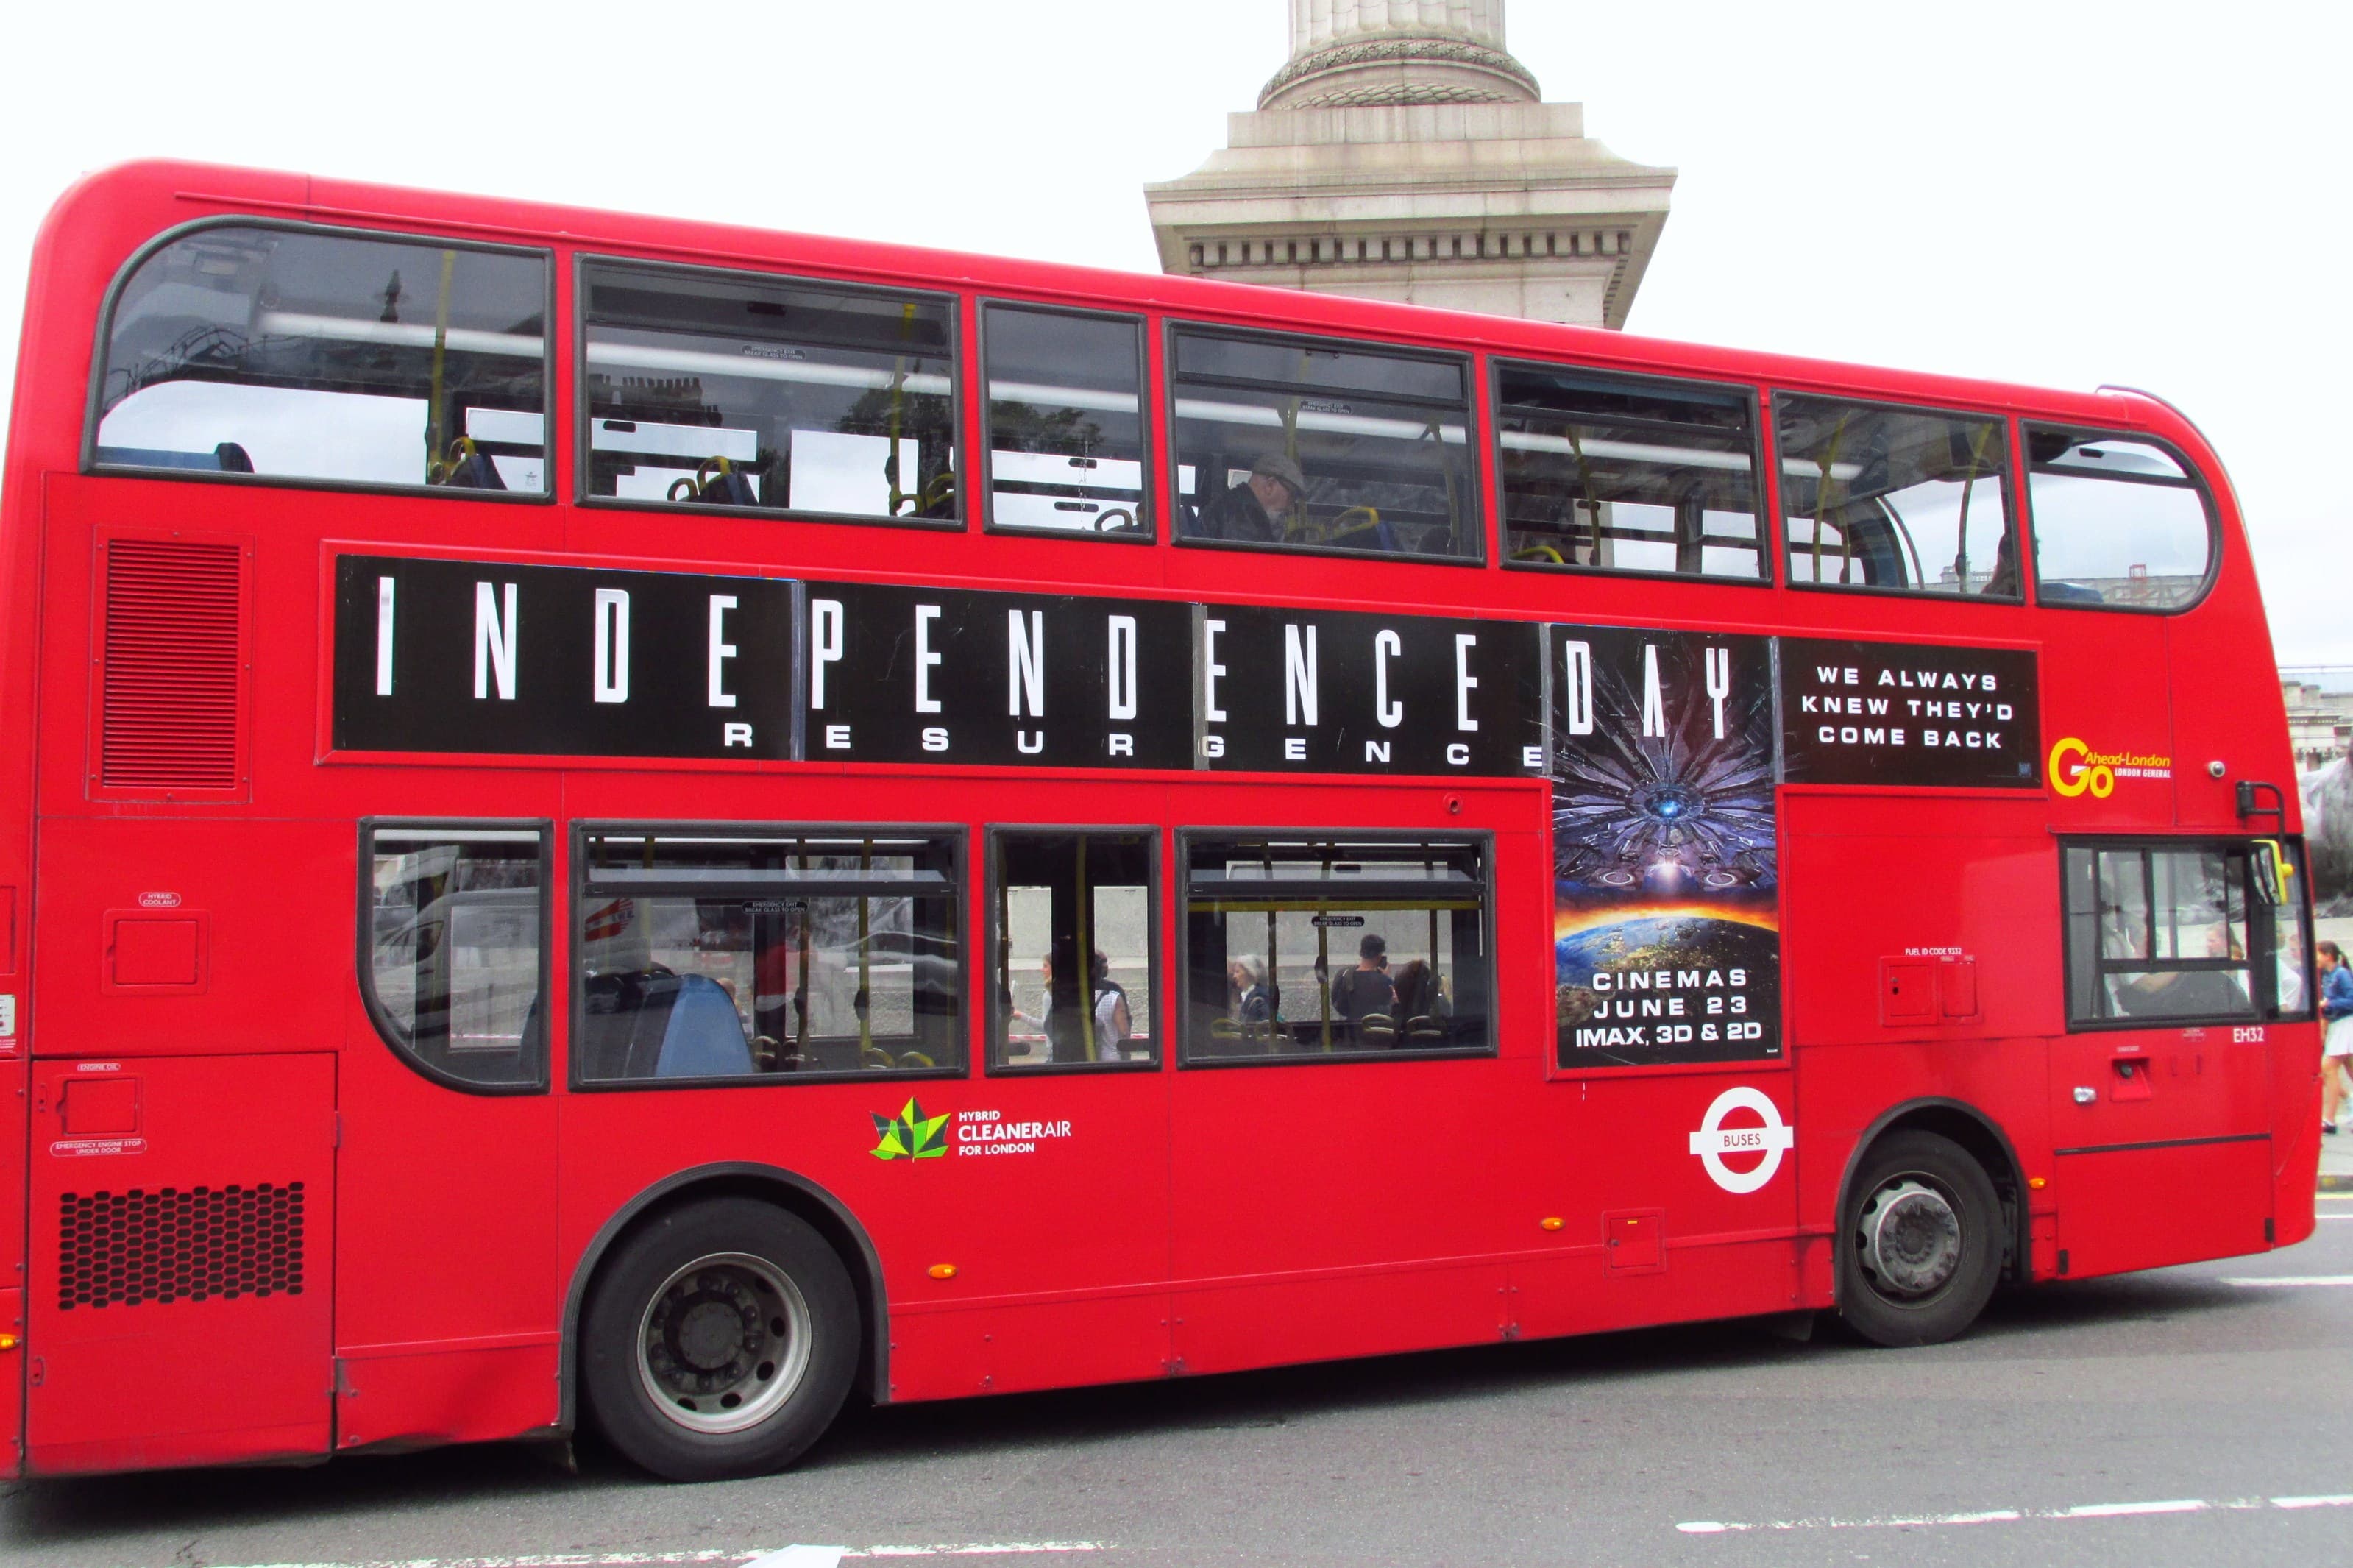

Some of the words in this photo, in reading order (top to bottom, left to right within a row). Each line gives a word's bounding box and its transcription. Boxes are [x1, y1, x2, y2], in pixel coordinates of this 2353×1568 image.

[377, 576, 1478, 732] INDEPENDENCE
[1566, 640, 1729, 739] DAY
[1816, 666, 1859, 684] WE
[1878, 670, 1996, 691] ALWAYS
[1802, 695, 1889, 714] KNEW
[1907, 700, 2012, 720] THEY'D
[724, 723, 1543, 767] RESURGENCE
[1818, 726, 1905, 745] COME
[1923, 730, 2001, 749] BACK
[2048, 737, 2114, 798] Go
[2084, 752, 2170, 767] Ahead-London
[2115, 767, 2141, 777] LONDON
[2143, 768, 2171, 778] GENERAL
[1905, 948, 1920, 956] FUEL
[1921, 948, 1928, 956] ID
[1592, 968, 1747, 990] CINEMAS
[1594, 998, 1684, 1019] JUNE
[1707, 996, 1747, 1014] 23
[1656, 1025, 1692, 1043] 3D
[1701, 1024, 1719, 1041] &
[1727, 1022, 1761, 1040] 2D
[2233, 1027, 2265, 1043] EH32
[959, 1110, 1001, 1122] HYBRID
[959, 1146, 982, 1156] FOR
[985, 1143, 1034, 1155] LONDON
[1724, 1132, 1761, 1147] BUSES
